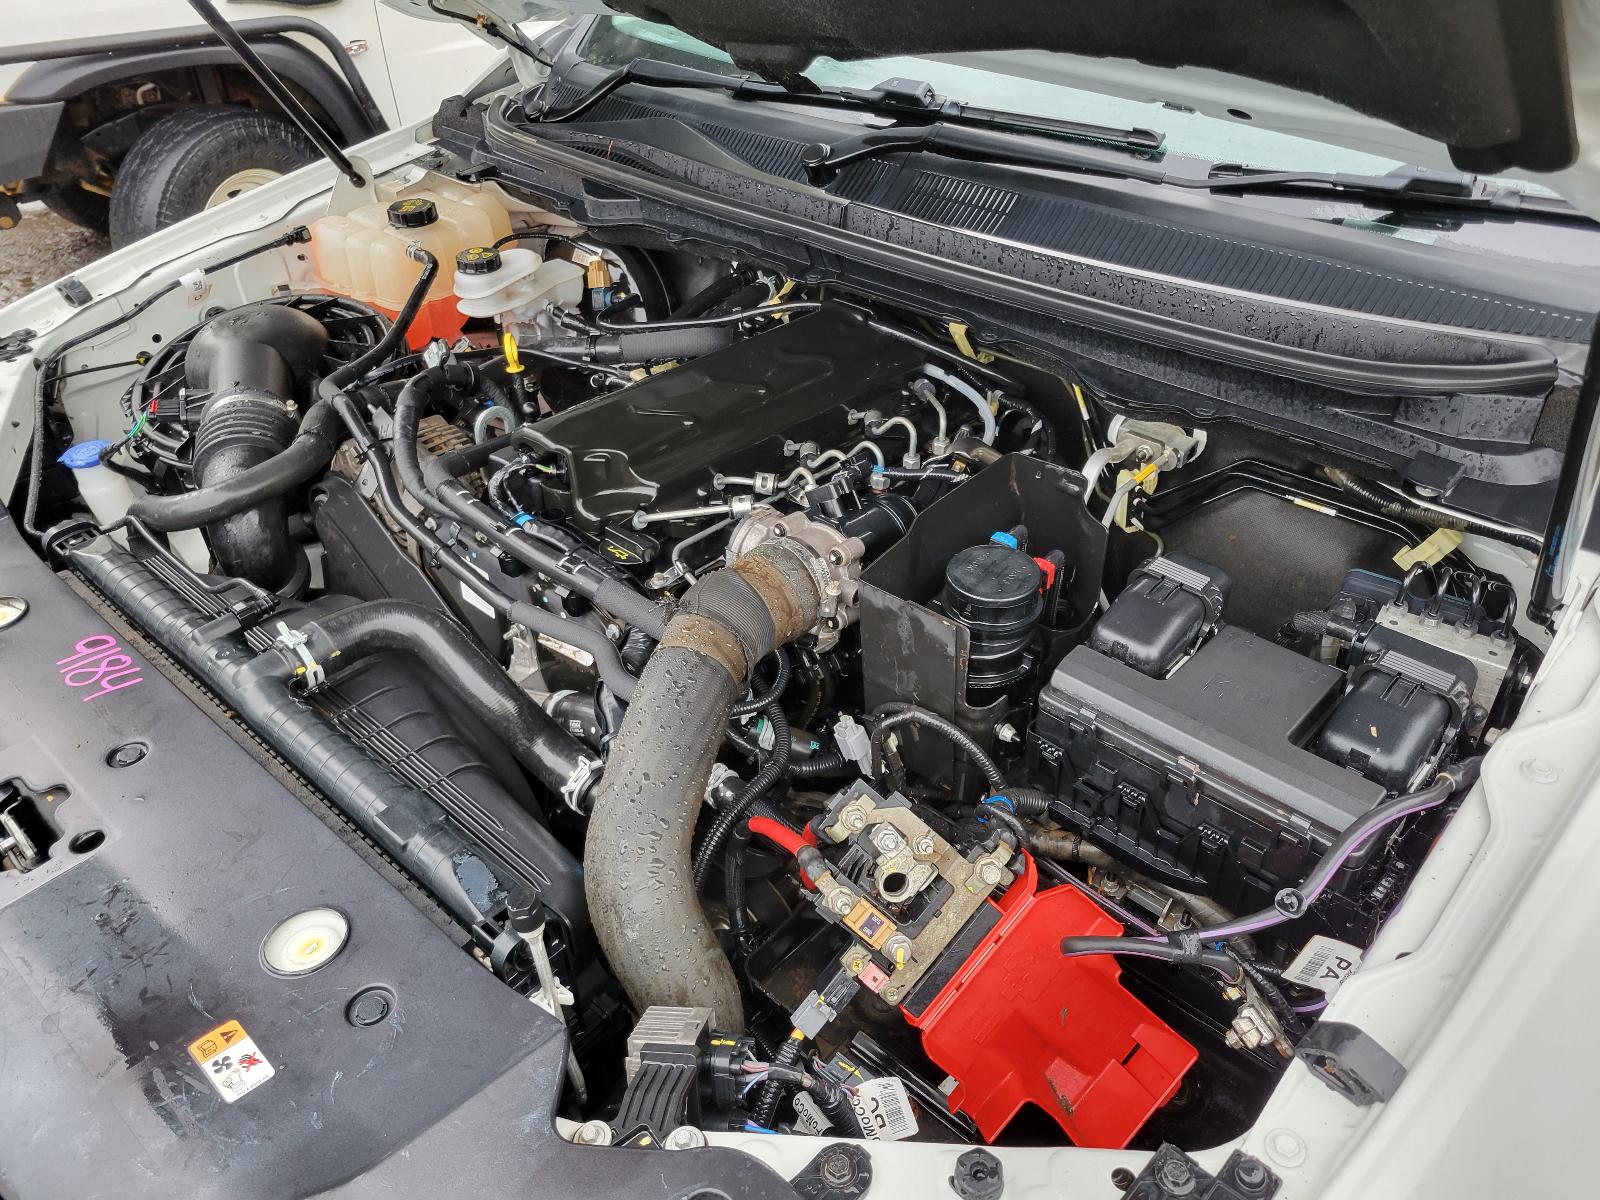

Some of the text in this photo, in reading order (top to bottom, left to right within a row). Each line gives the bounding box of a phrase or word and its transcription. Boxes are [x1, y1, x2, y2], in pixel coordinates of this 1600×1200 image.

[56, 634, 143, 701] 9184
[1319, 955, 1353, 980] PA
[793, 1097, 823, 1137] FoMoCo
